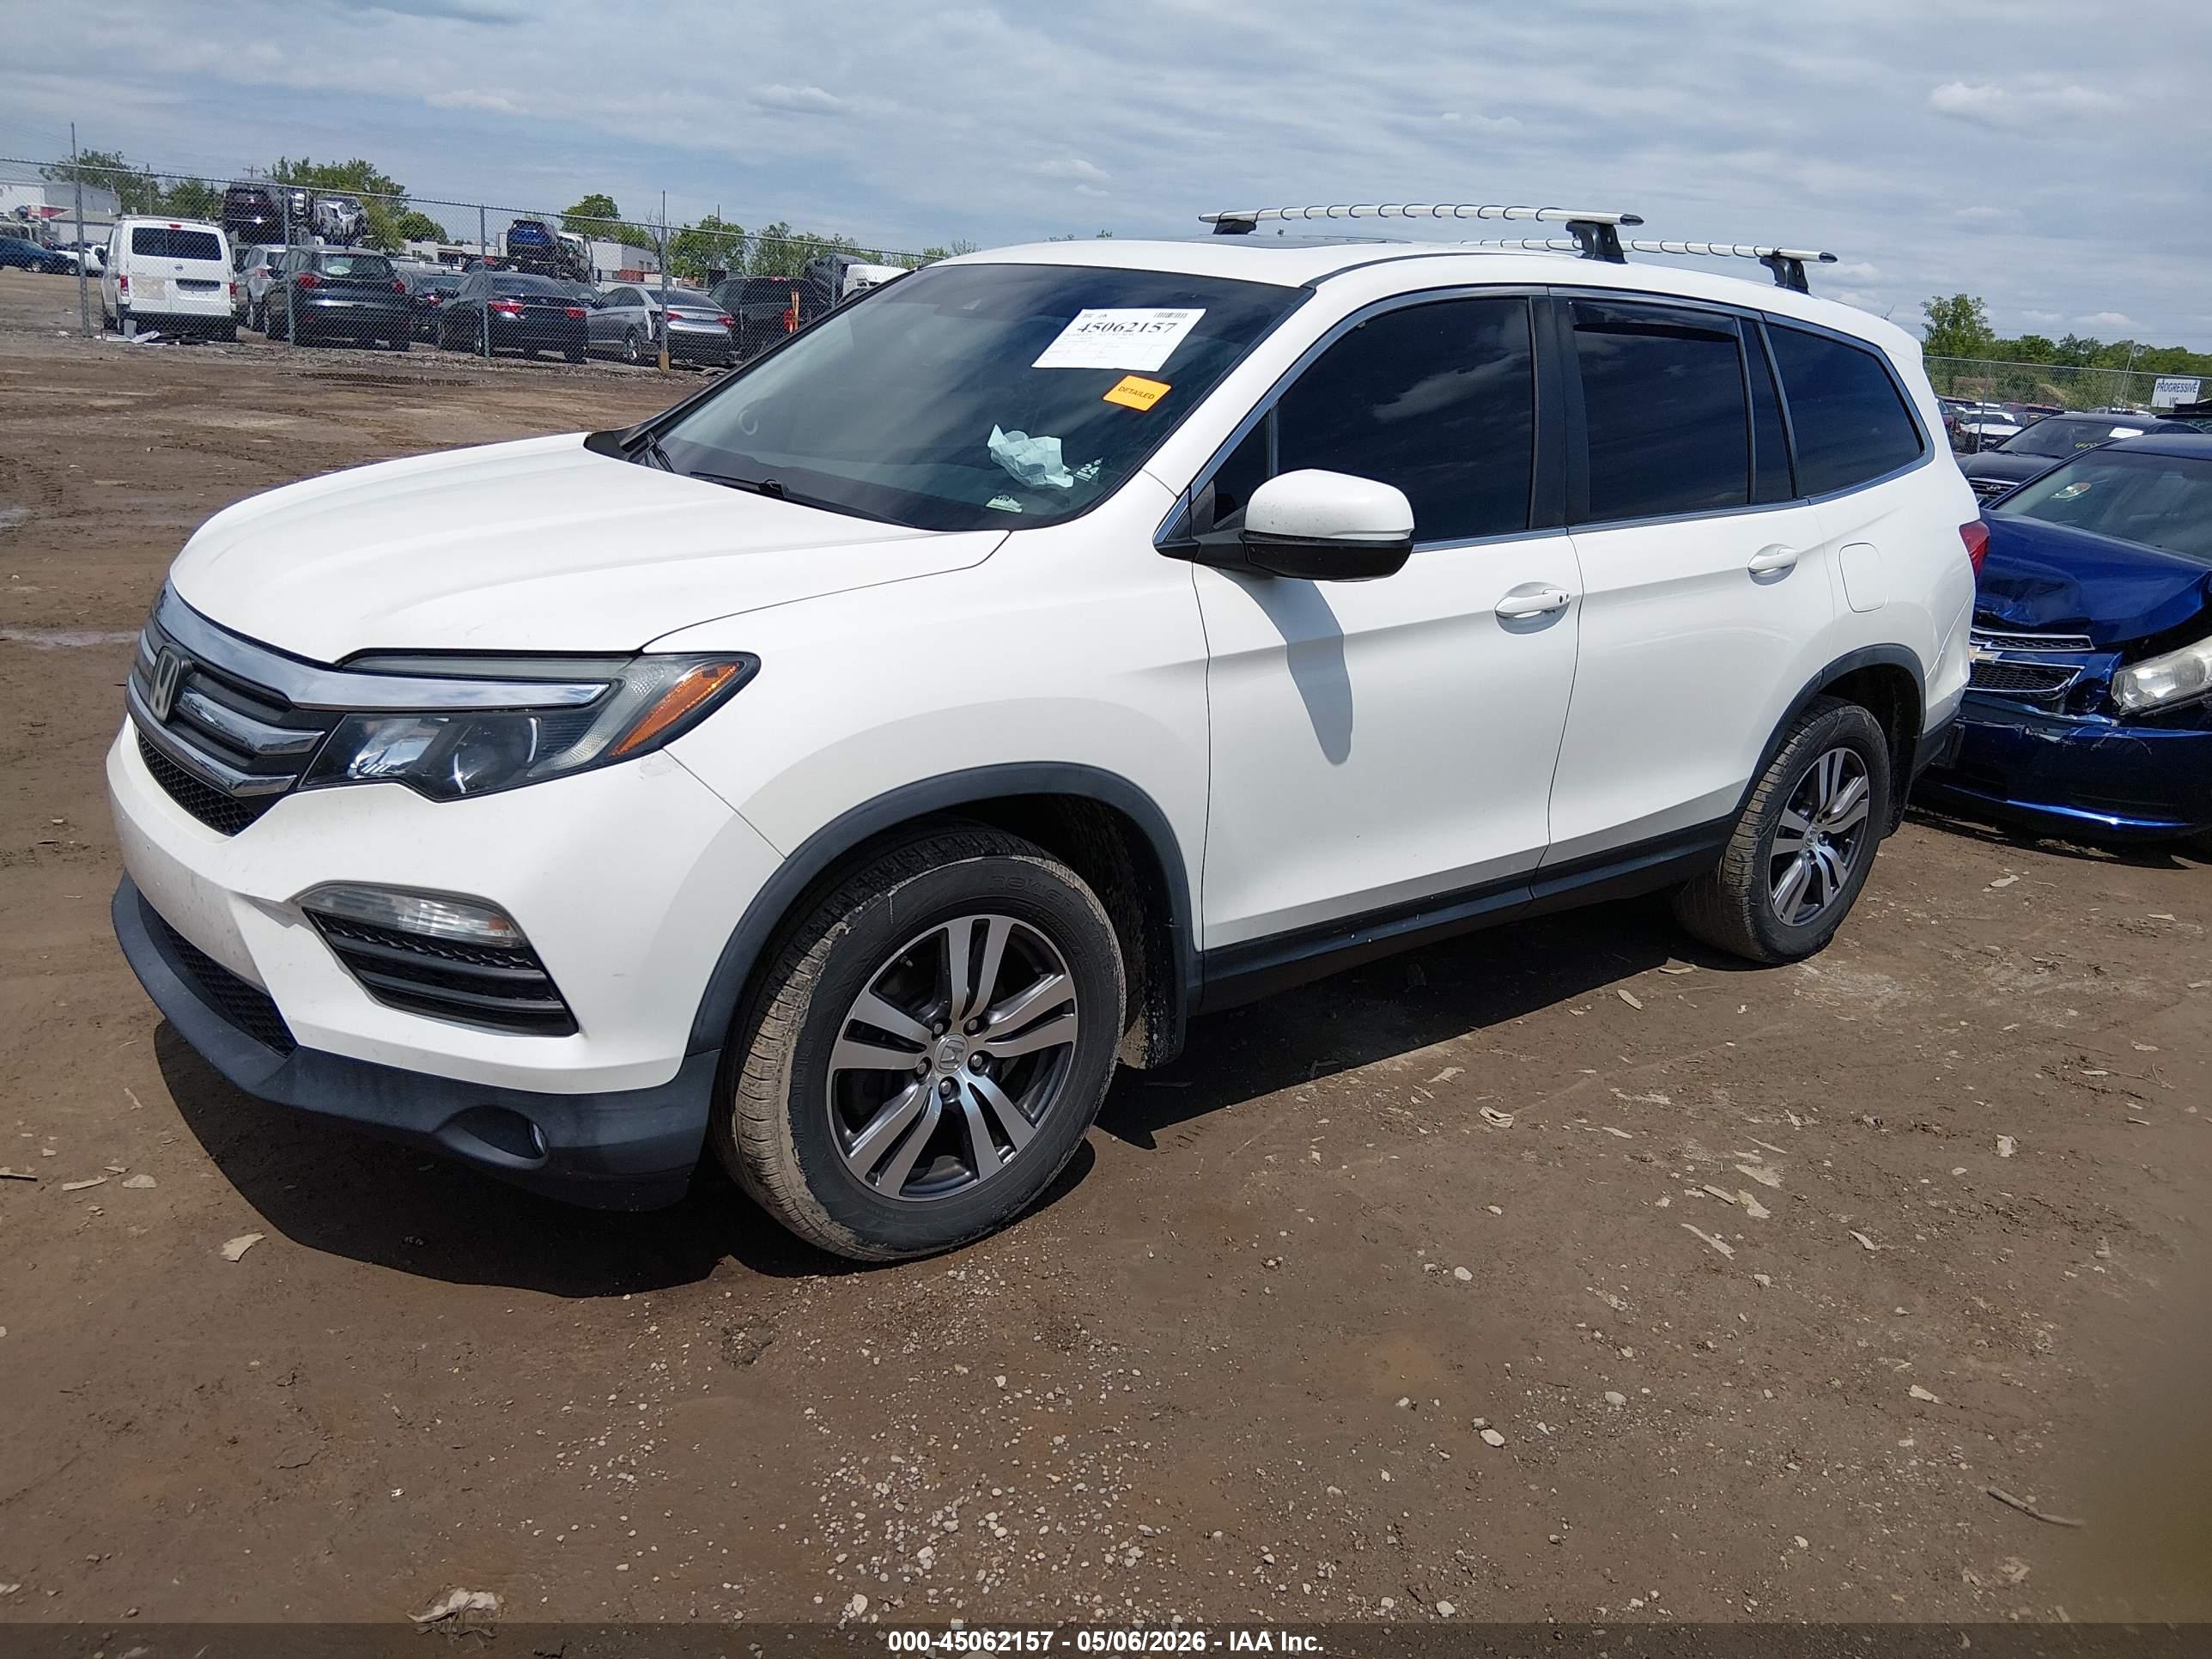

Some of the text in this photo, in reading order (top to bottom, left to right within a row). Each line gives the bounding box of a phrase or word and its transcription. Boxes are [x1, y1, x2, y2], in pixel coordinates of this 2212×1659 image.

[1078, 322, 1178, 333] 45062157
[1118, 386, 1155, 399] DETAILED
[2156, 382, 2198, 392] PROGRESSIVE
[1080, 464, 1100, 475] 24
